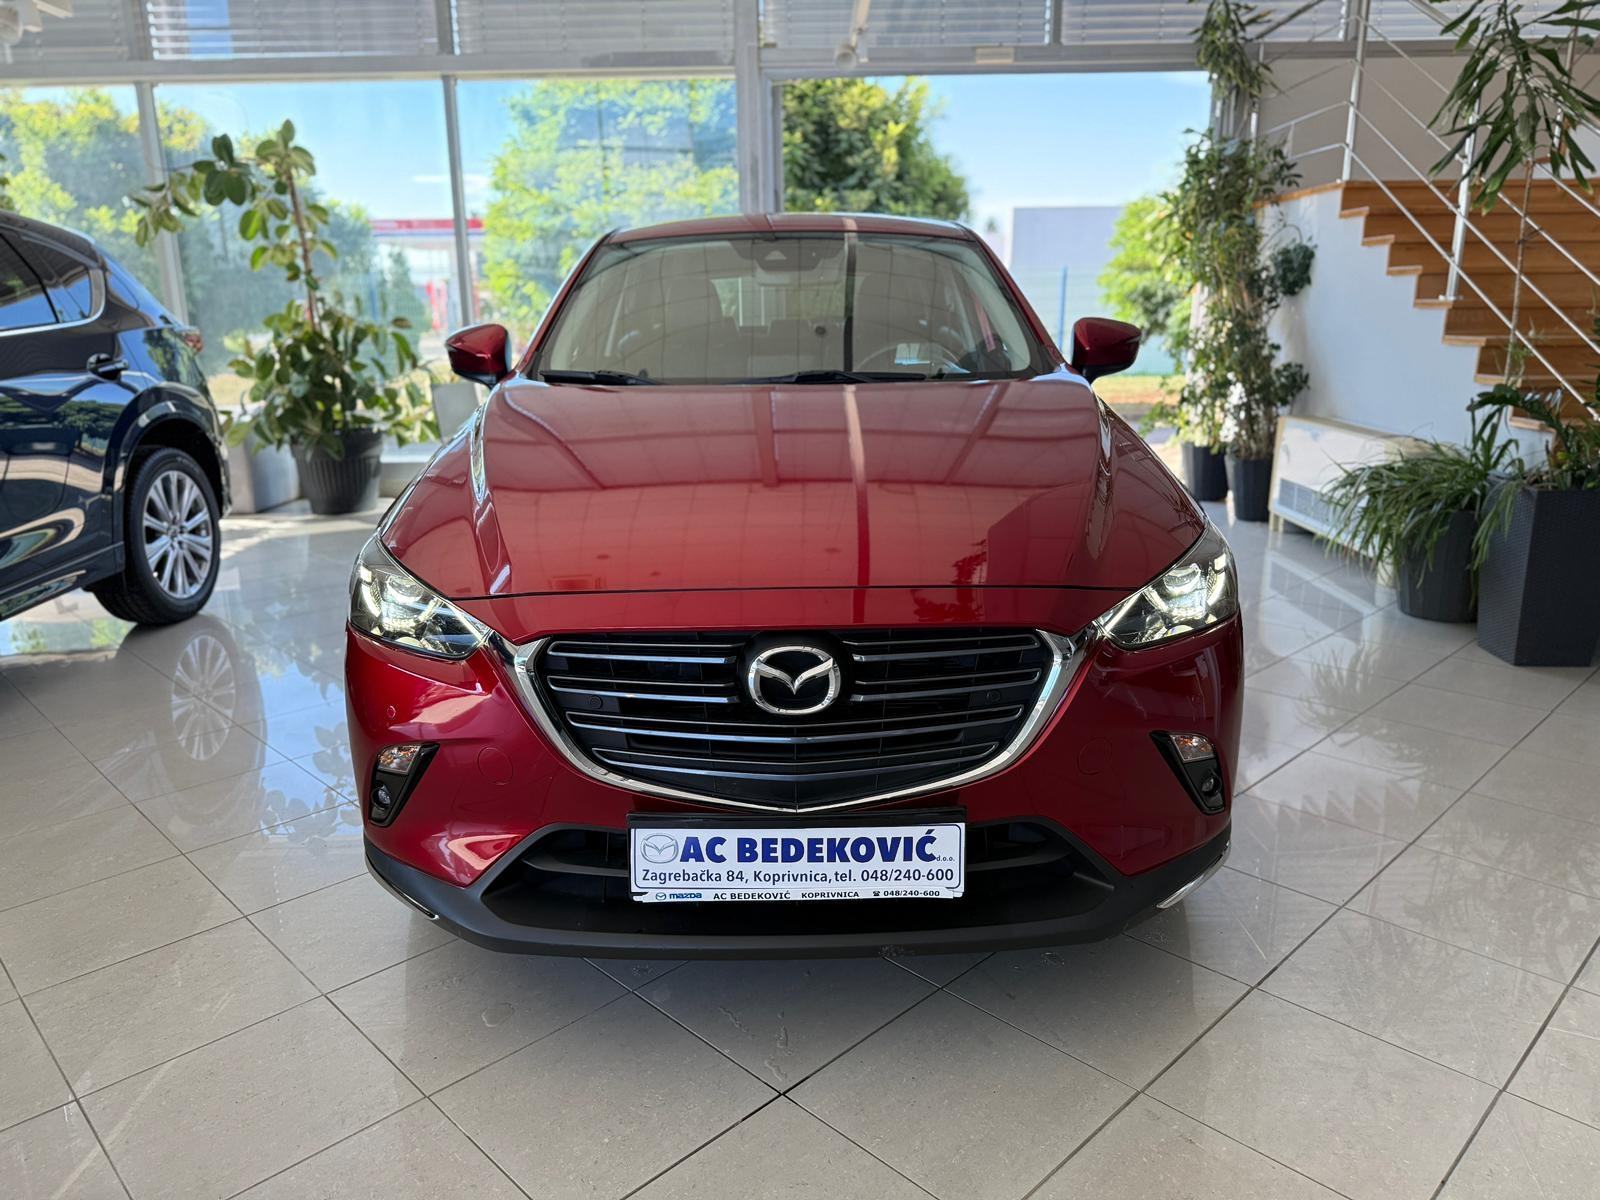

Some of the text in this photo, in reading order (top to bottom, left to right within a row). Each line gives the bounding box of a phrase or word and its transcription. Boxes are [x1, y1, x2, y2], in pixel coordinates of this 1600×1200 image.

[679, 836, 728, 863] AC
[736, 829, 937, 863] BEDEKOVIĆ
[642, 868, 954, 885] Zagrebačka 84, Koprivnica, tel. 048/240-600
[713, 892, 727, 900] AC
[730, 890, 791, 900] BEDEKOVIĆ
[801, 891, 860, 899] KOPRIVNICA
